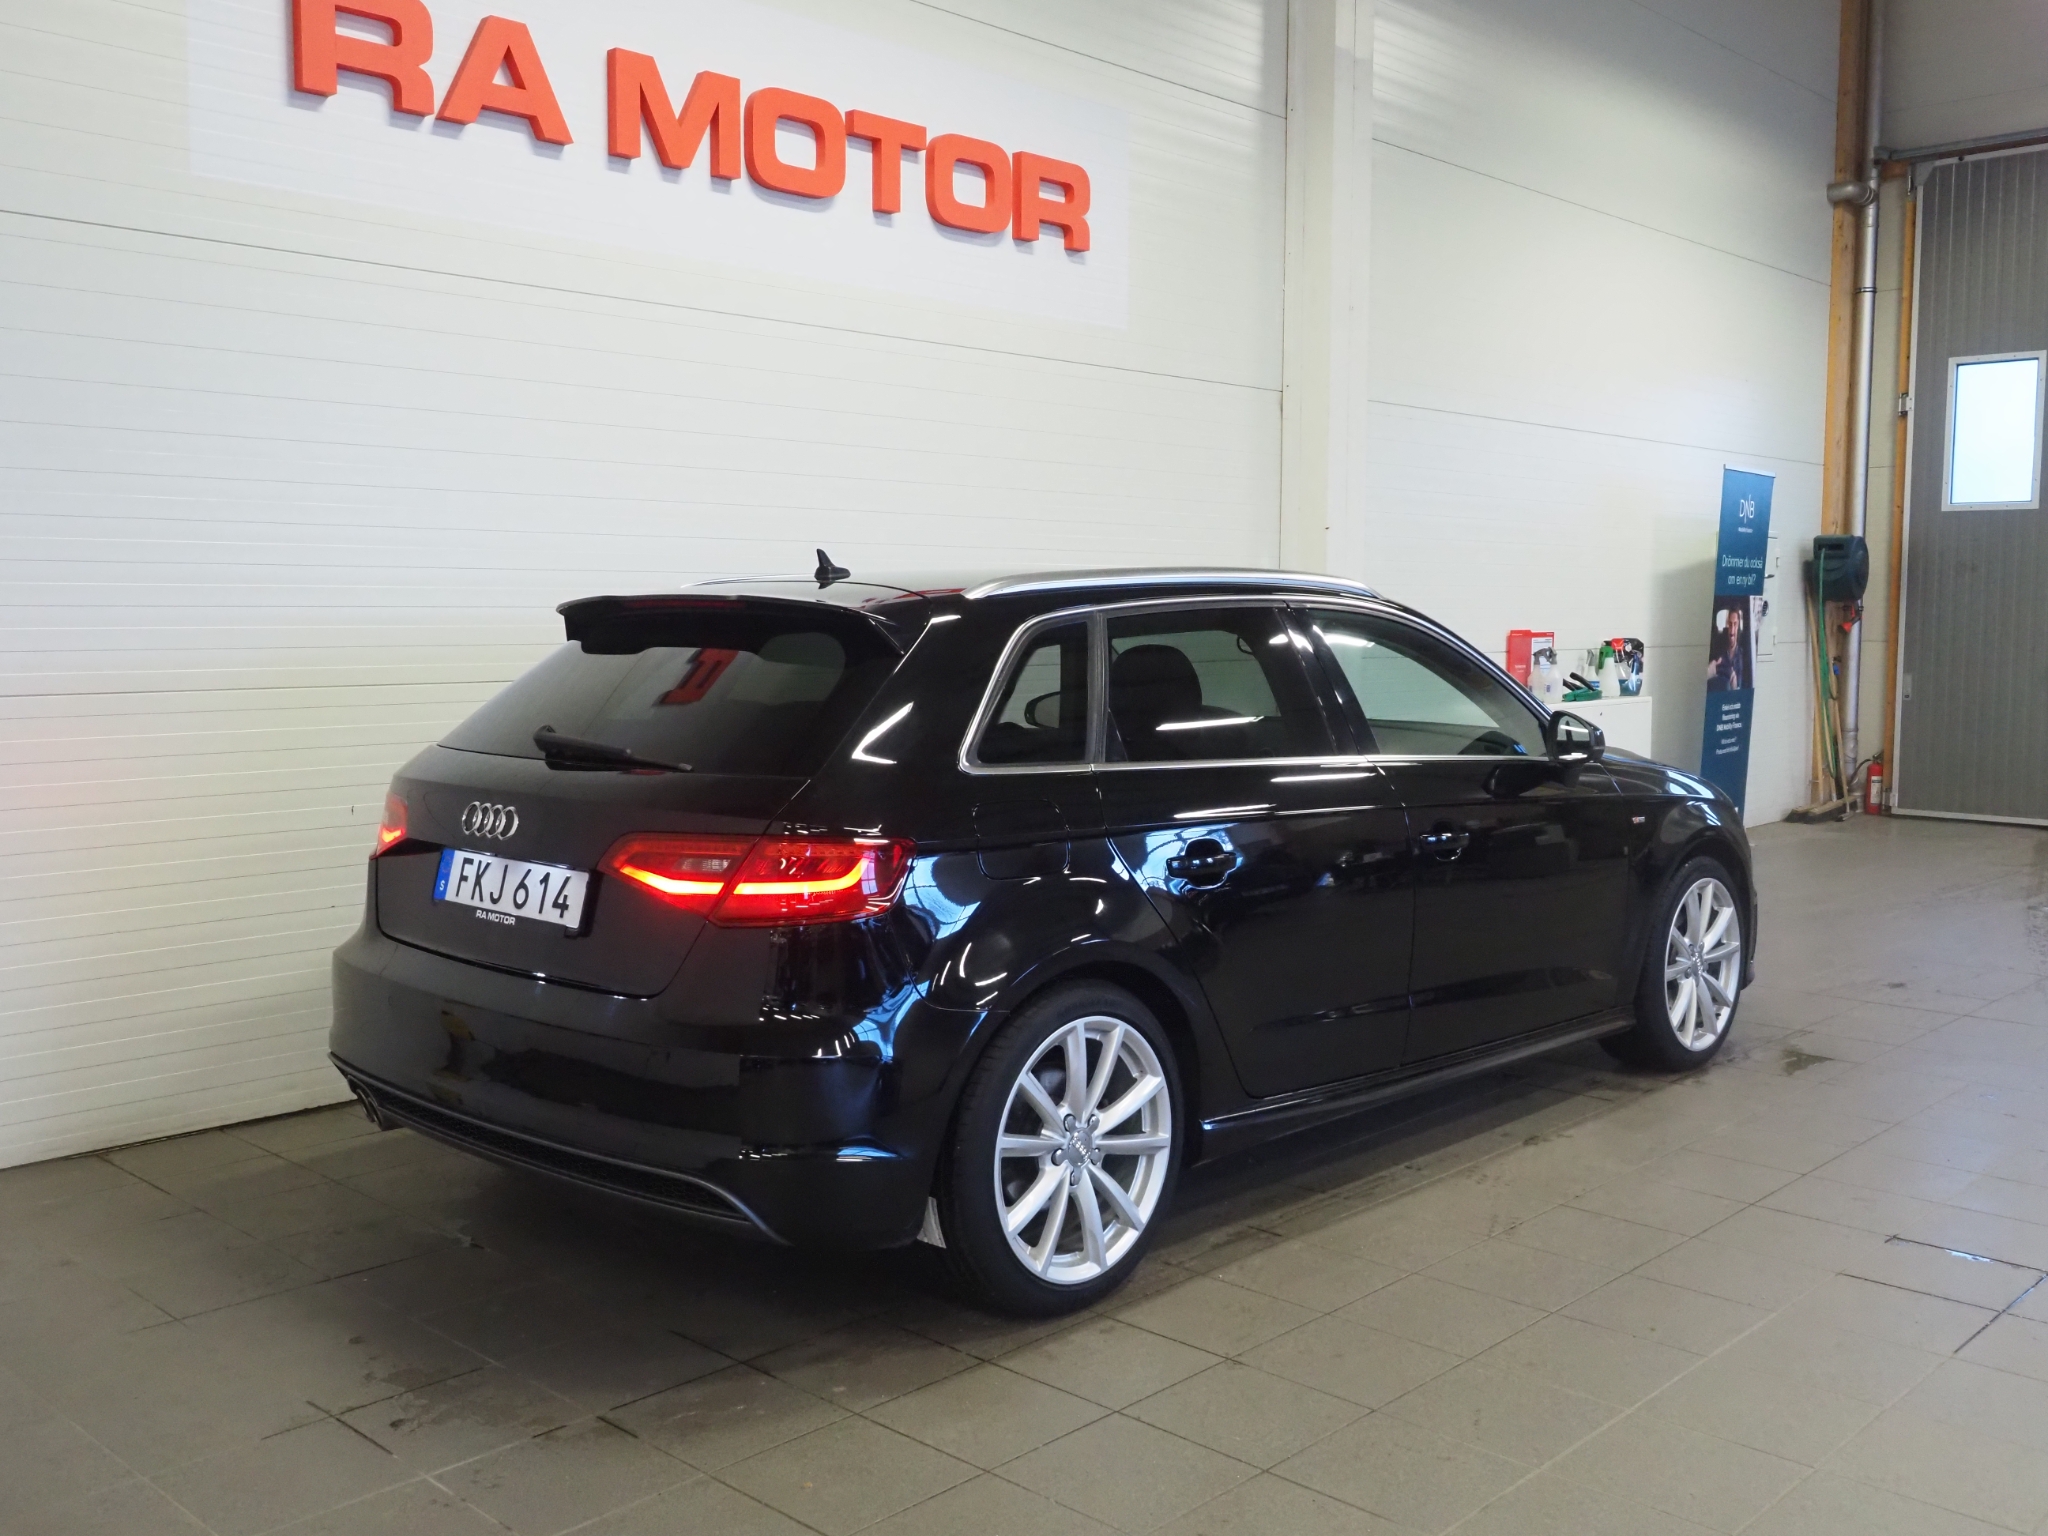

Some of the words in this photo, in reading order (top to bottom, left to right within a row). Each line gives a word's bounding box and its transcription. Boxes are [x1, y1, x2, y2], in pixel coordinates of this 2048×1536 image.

[292, 0, 574, 146] RA
[607, 47, 1091, 252] MOTOR
[1739, 494, 1755, 524] DNB
[439, 880, 445, 891] S
[455, 856, 508, 905] FKJ
[513, 868, 573, 919] 614
[475, 909, 487, 920] RA
[487, 911, 516, 926] MOTOR
